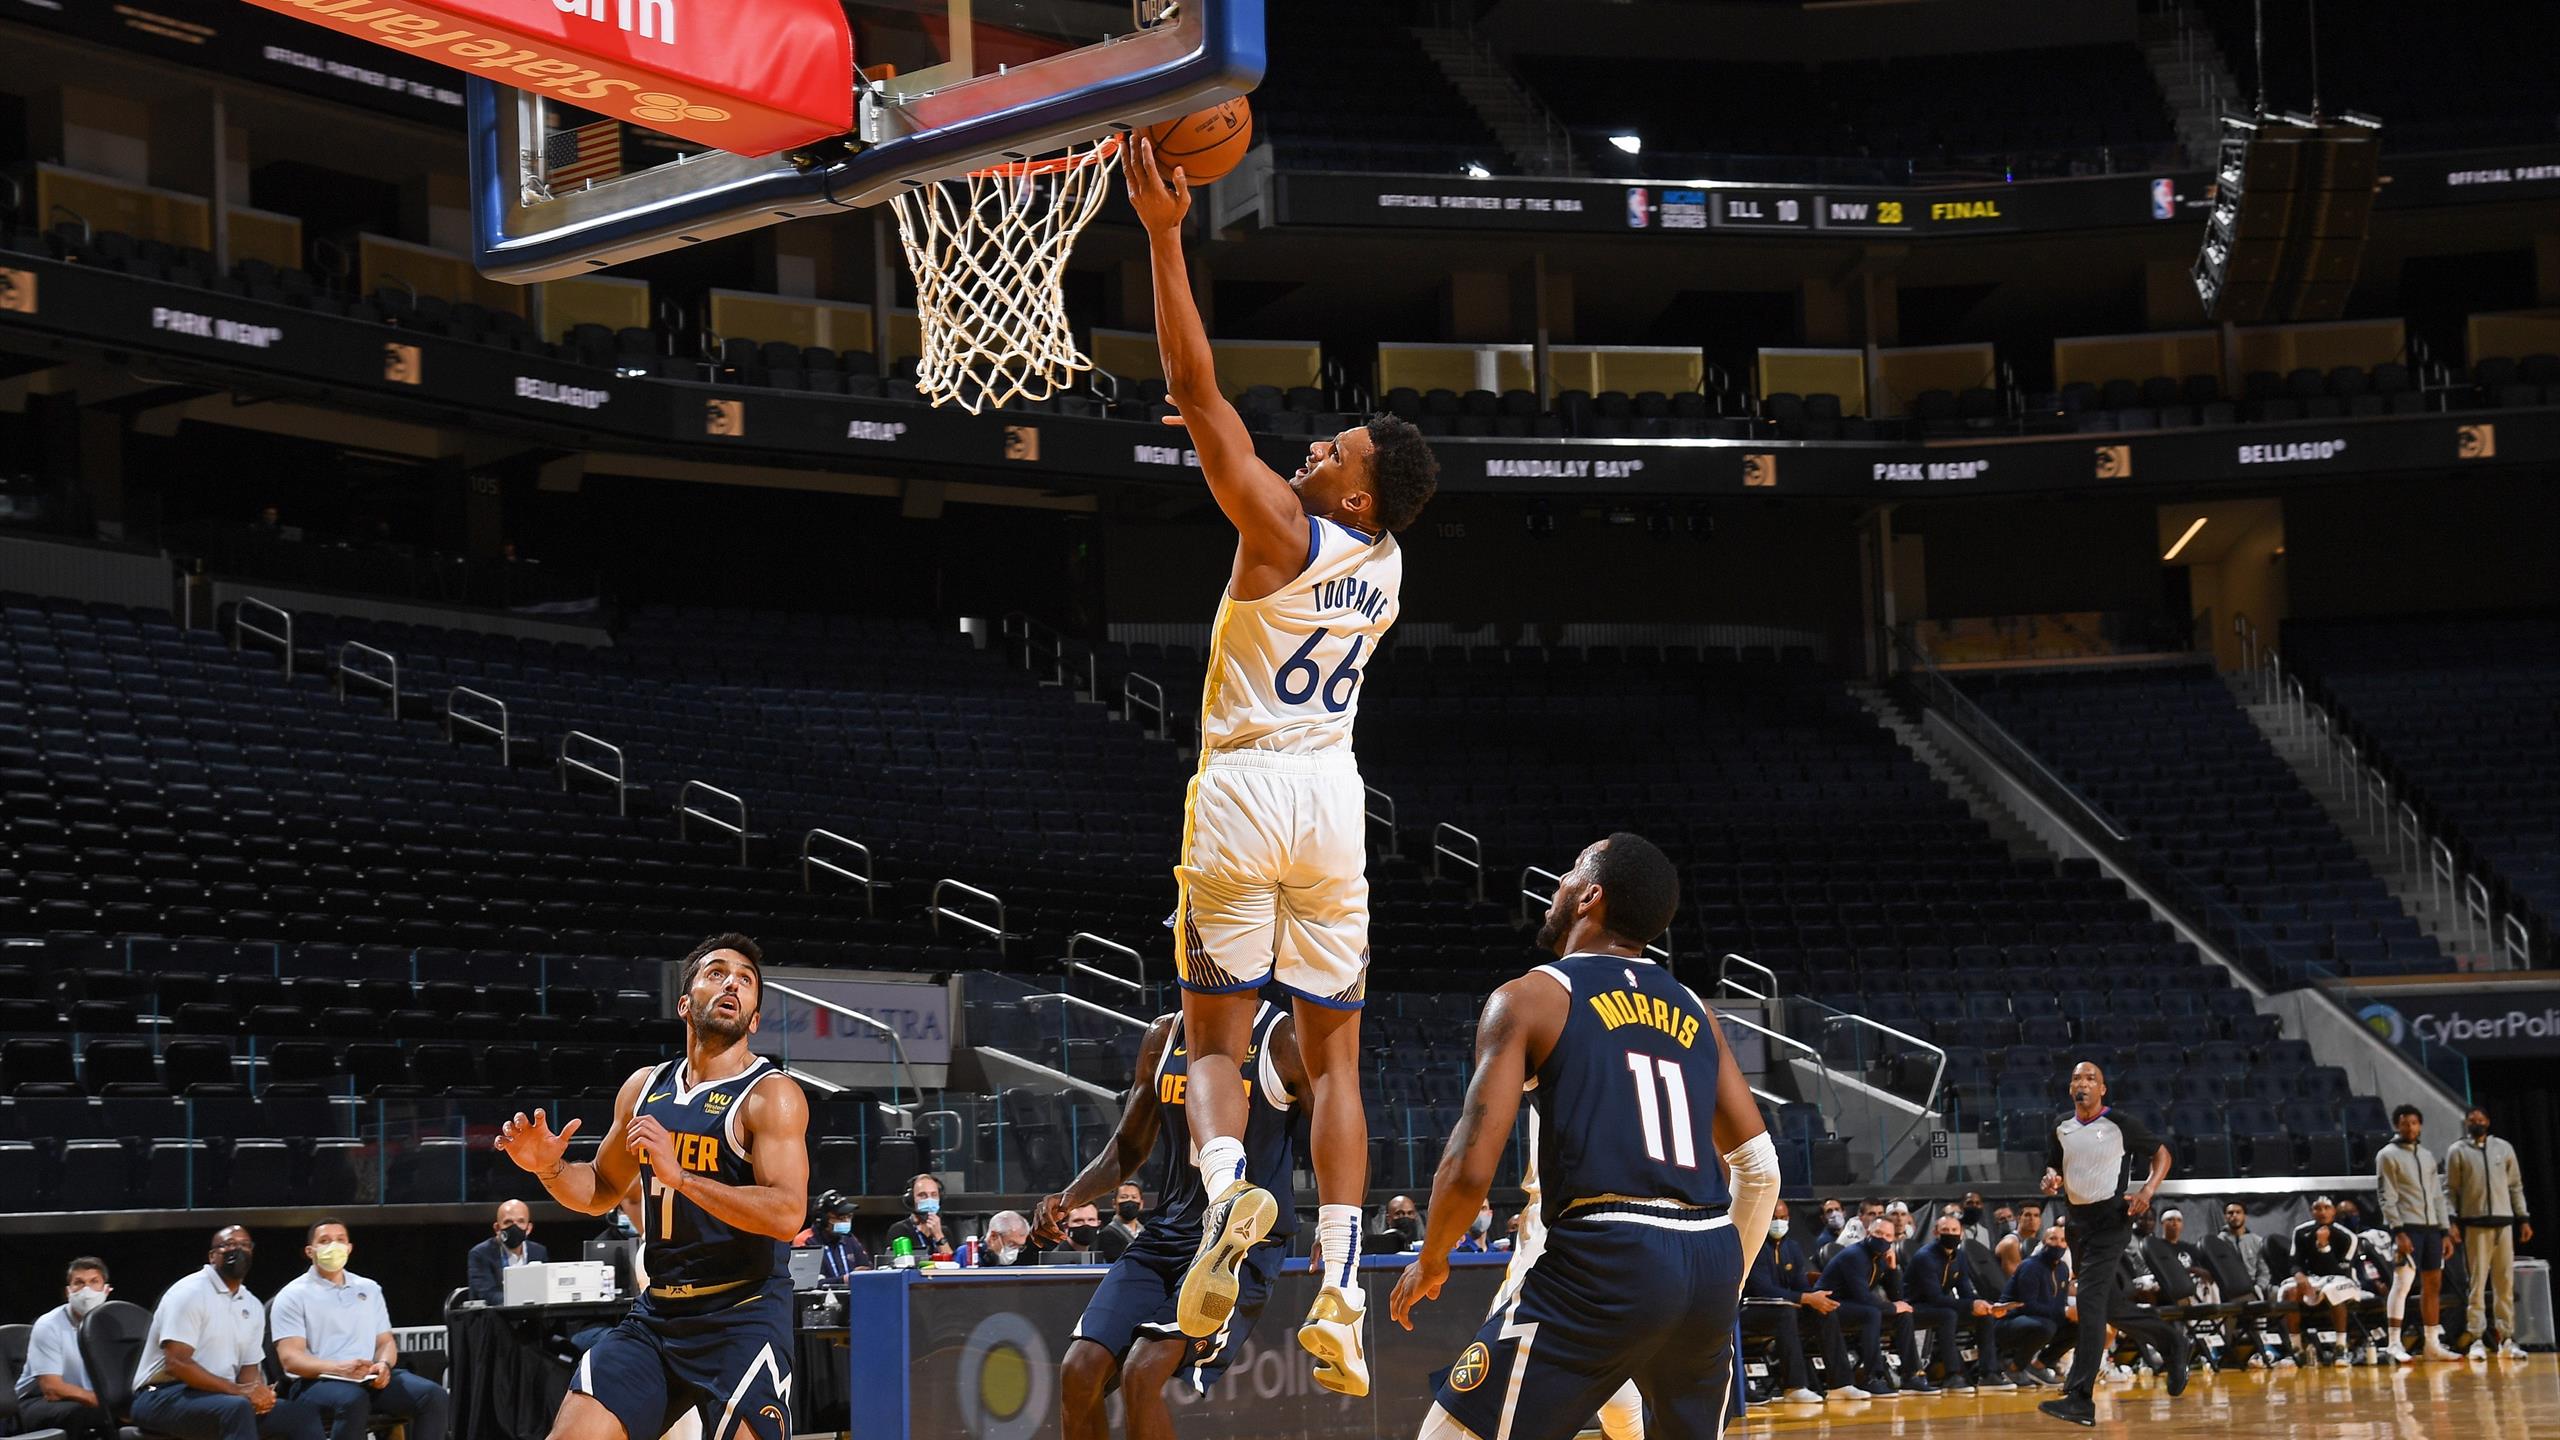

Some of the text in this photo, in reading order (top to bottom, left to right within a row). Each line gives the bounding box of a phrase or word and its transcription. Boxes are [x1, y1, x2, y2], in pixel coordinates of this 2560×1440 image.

[2447, 169, 2512, 186] OFFICIAL
[1378, 194, 1583, 212] OFFICIAL PARTNER OF THE NBA
[1728, 199, 1799, 222] ILL 10
[1831, 201, 1903, 224] NW 28
[1931, 200, 2002, 221] FINAL
[1661, 214, 1707, 229] SCORES
[152, 307, 214, 338] PARK
[1134, 445, 1180, 466] MGM
[1486, 459, 1590, 478] MANDALAY
[1873, 463, 1924, 480] PARK
[1312, 577, 1388, 625] TOUPANE
[1275, 627, 1364, 713] 66
[836, 1006, 944, 1041] ULTRA
[1589, 990, 1700, 1049] MORRIS
[708, 1091, 733, 1106] WU
[1626, 1050, 1697, 1169] 11
[1934, 1132, 1946, 1143] 16
[1935, 1146, 1946, 1157] 15
[650, 1176, 675, 1240] 7
